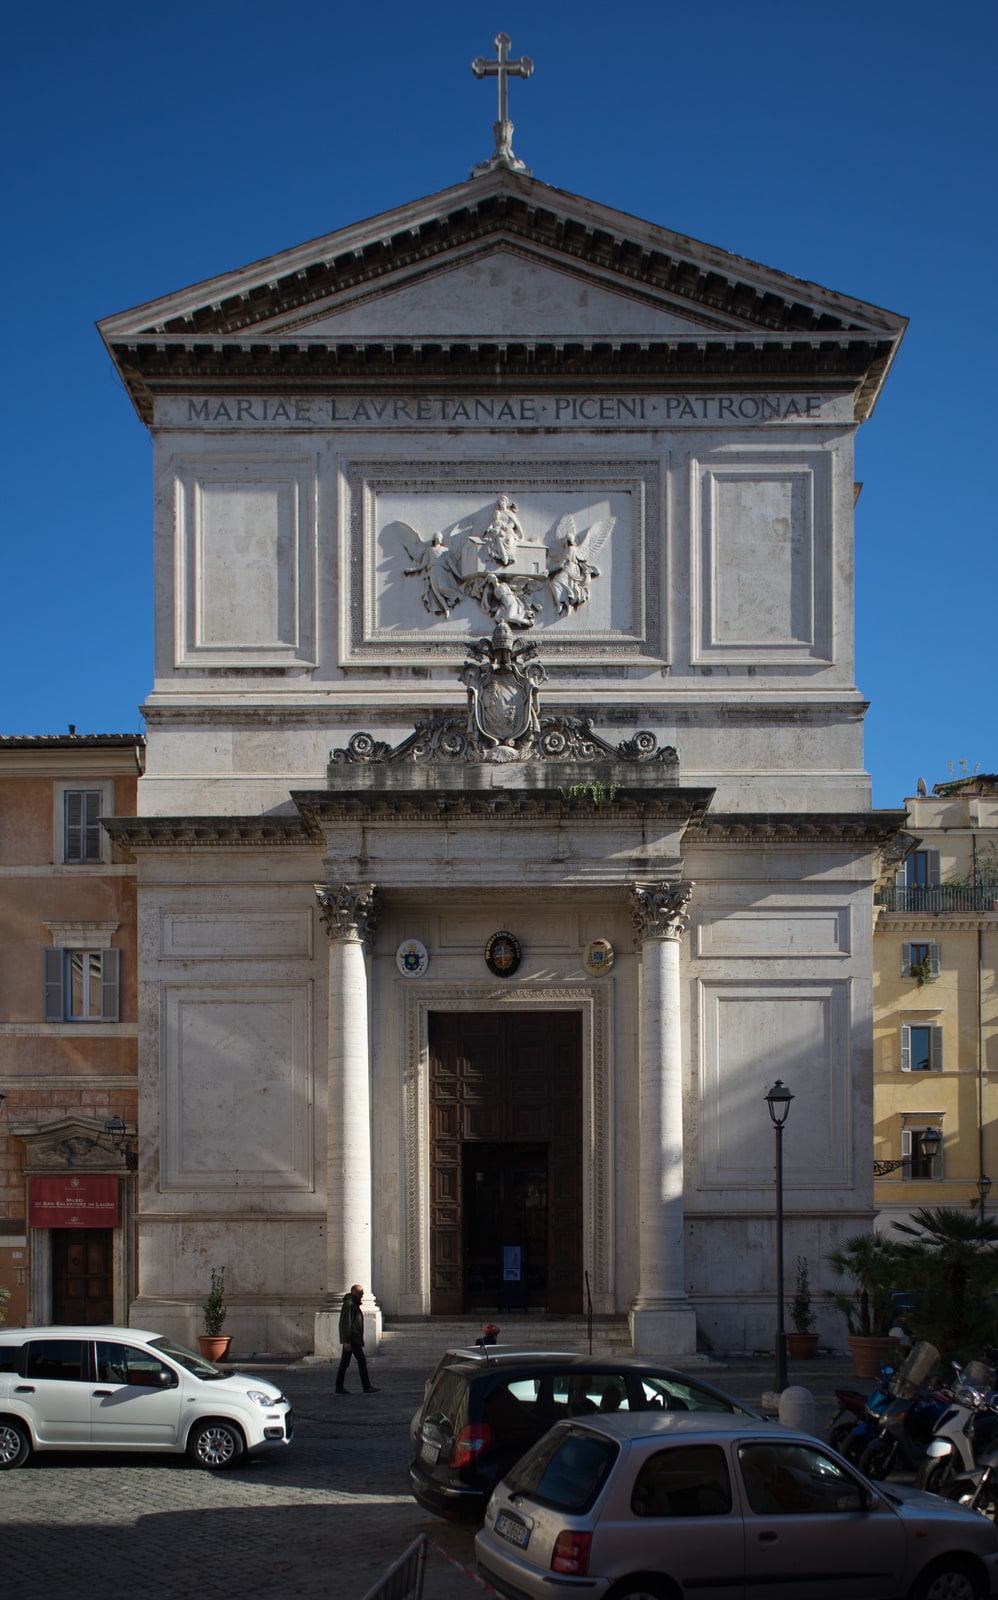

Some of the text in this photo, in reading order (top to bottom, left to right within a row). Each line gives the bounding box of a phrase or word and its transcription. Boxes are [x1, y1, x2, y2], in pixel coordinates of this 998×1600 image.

[188, 396, 822, 422] MARIAE LAVRETANAE PICENI PATRONAE
